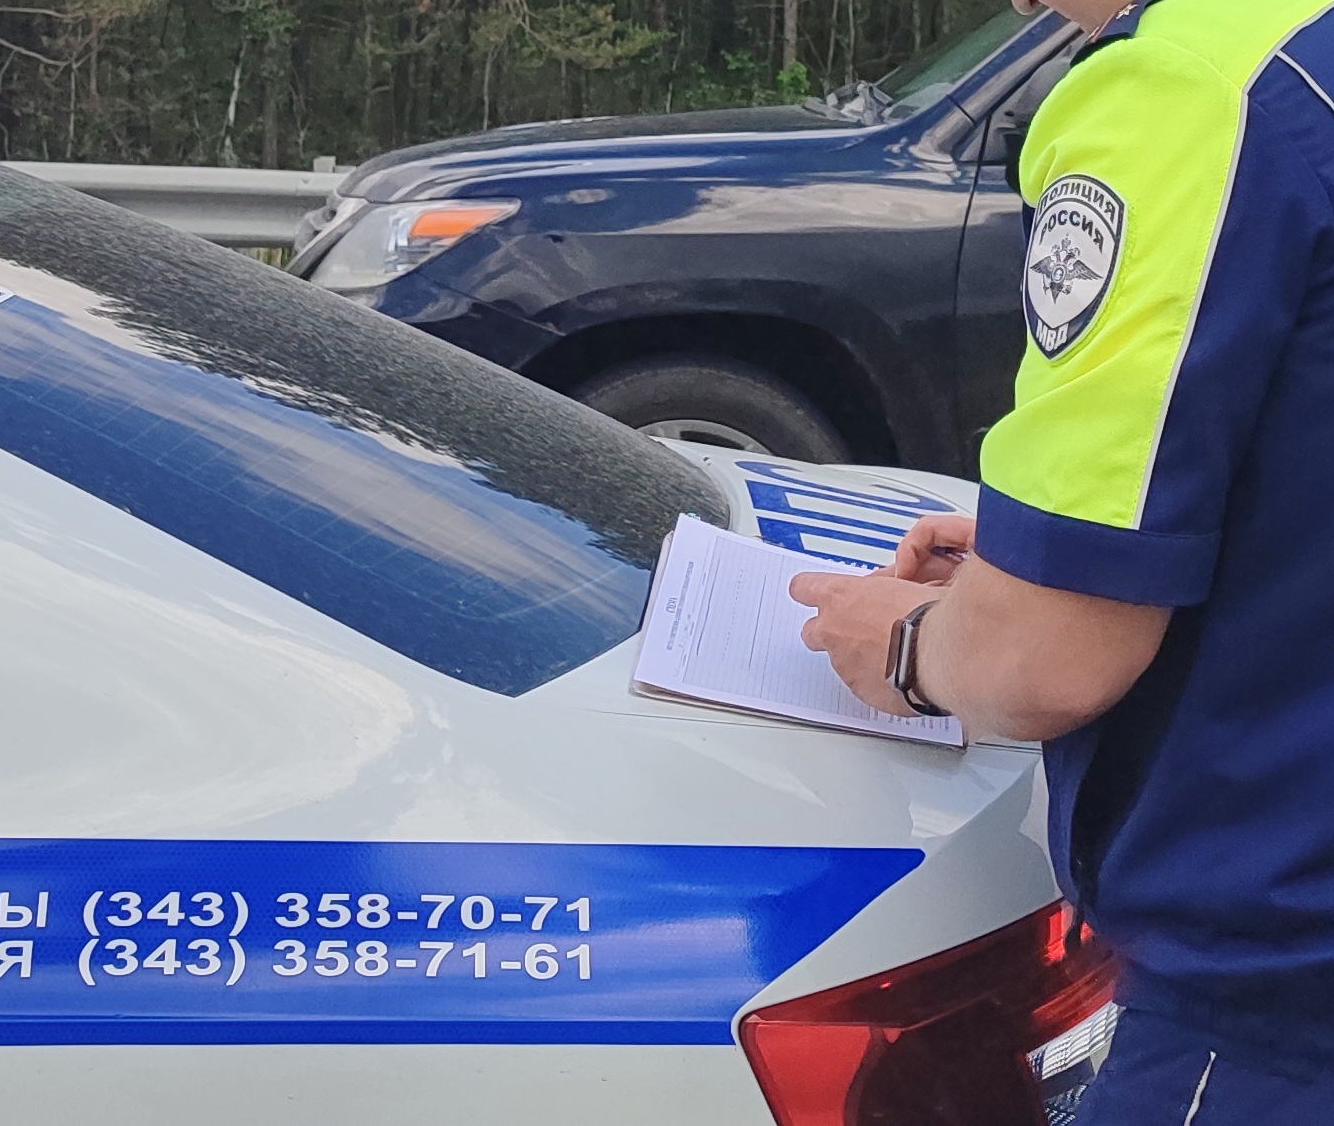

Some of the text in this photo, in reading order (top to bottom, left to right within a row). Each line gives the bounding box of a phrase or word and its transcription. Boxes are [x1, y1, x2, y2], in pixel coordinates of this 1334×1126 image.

[1038, 181, 1117, 224] ПОЛИЦИЯ
[1038, 209, 1105, 254] РОССИЯ
[1035, 318, 1069, 352] МВД
[83, 891, 250, 937] (343)
[274, 892, 592, 932] 358-70-71
[78, 938, 247, 986] (343)
[271, 939, 592, 980] 358-71-61
